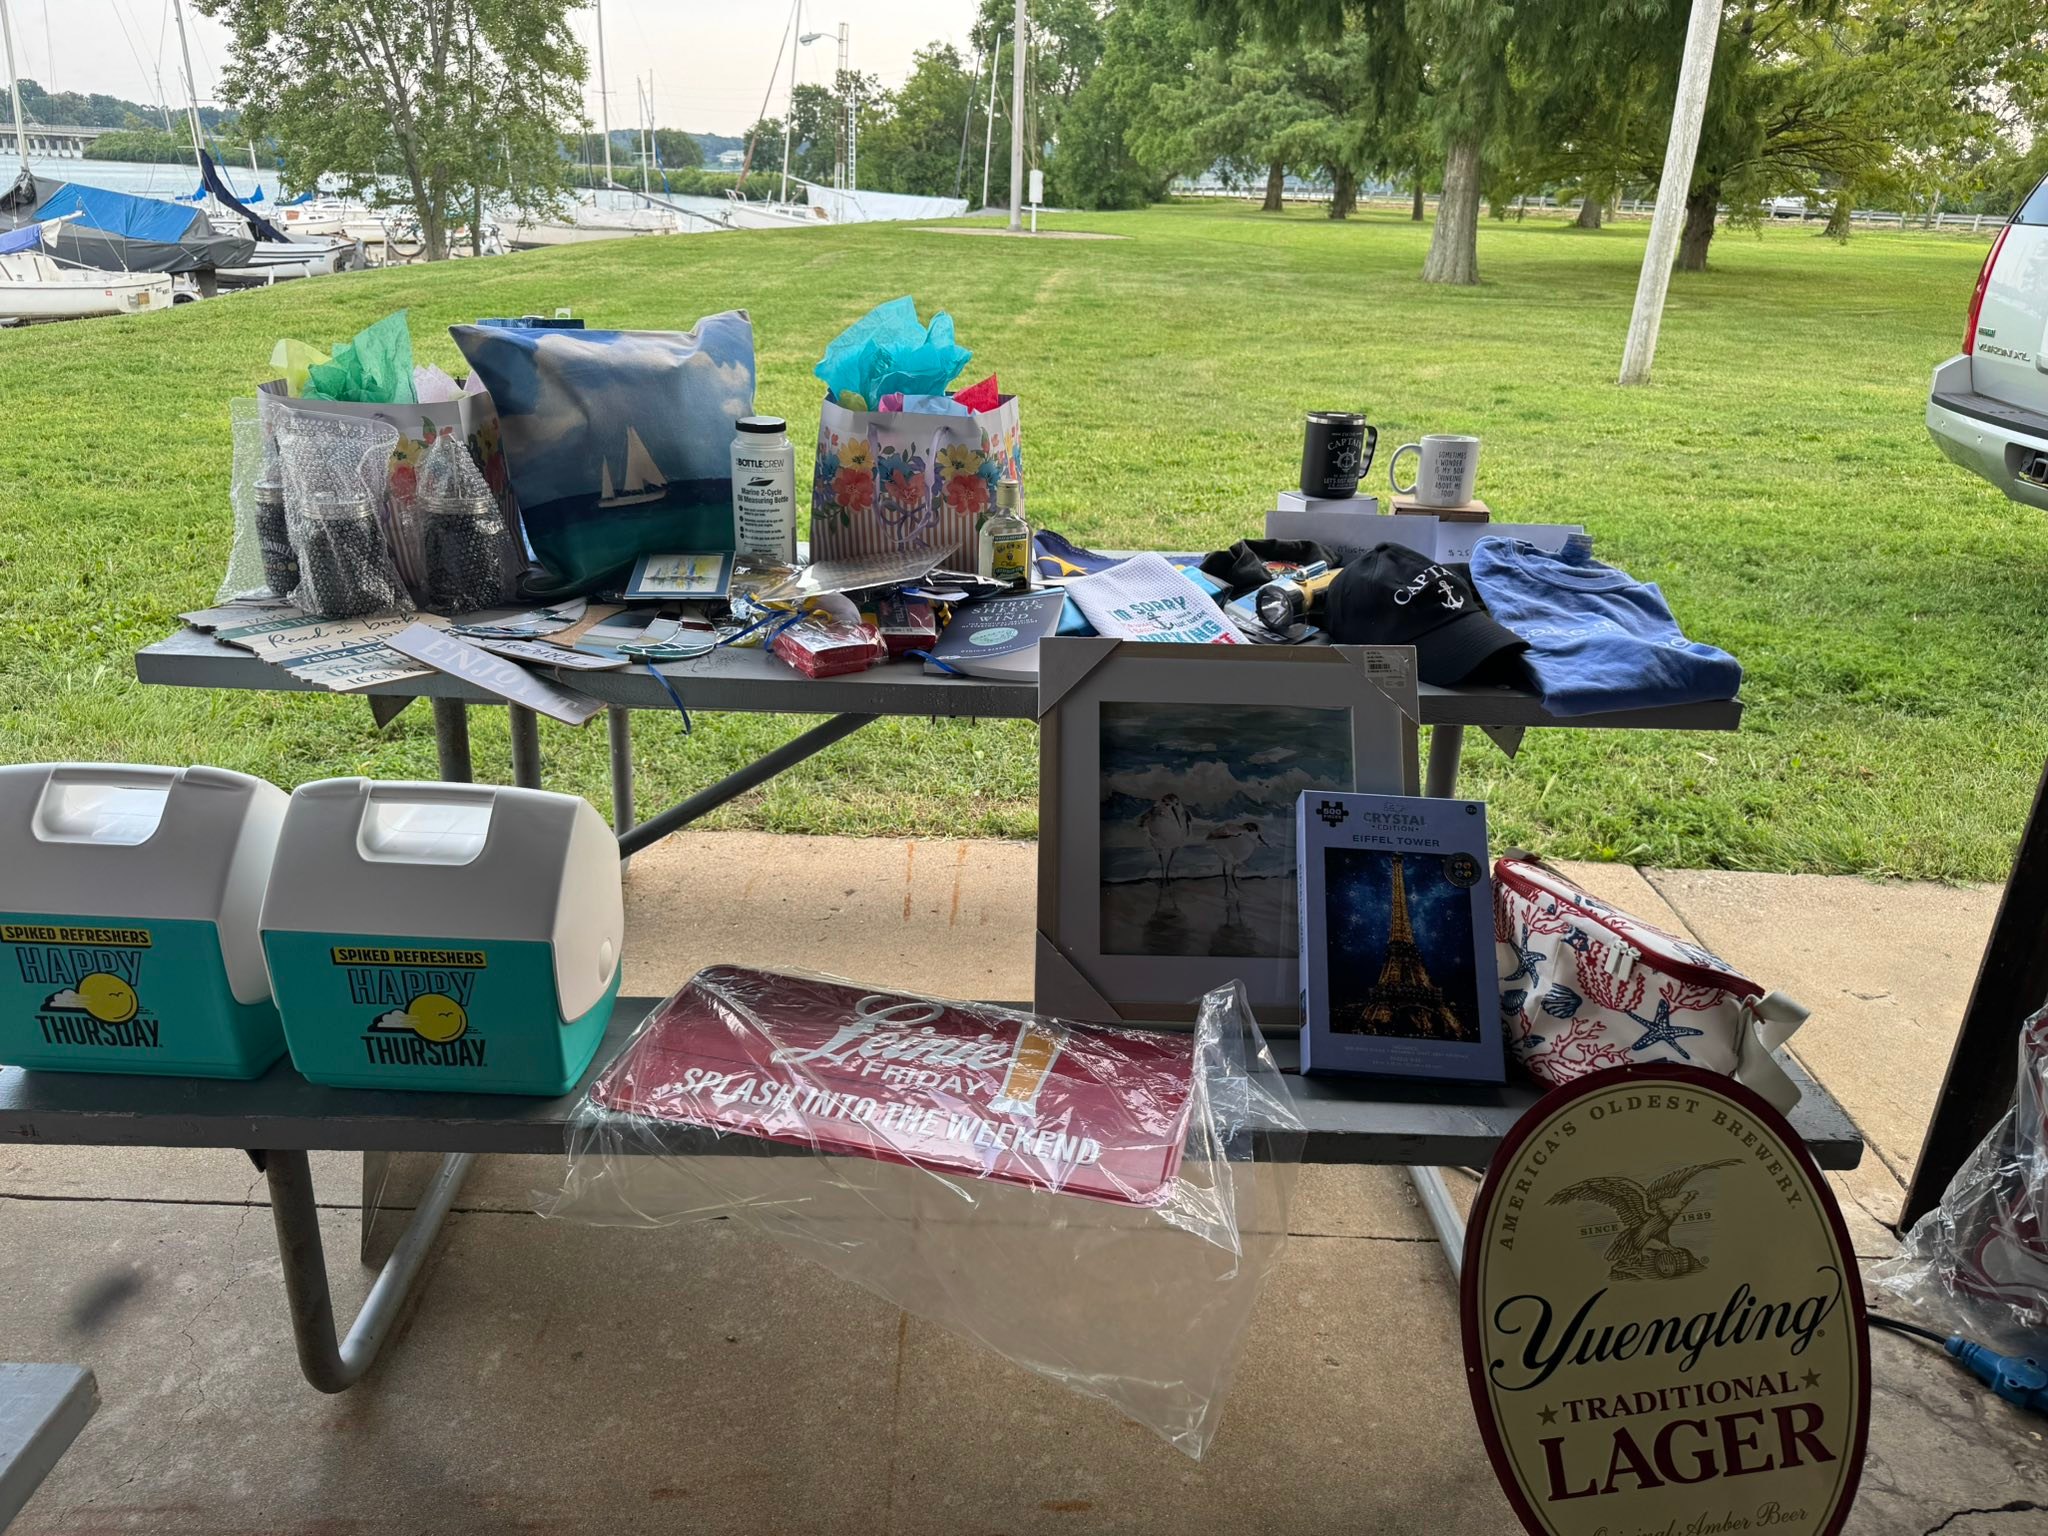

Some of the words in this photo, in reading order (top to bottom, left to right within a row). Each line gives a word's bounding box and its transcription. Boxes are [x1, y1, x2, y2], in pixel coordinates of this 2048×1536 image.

[1978, 342, 2012, 358] YUKON
[2013, 350, 2031, 362] XL
[1327, 437, 1362, 451] CAPTAIN
[741, 488, 759, 497] Marine
[761, 489, 783, 499] 2-Cycle
[744, 496, 773, 505] Measuring
[1393, 564, 1456, 606] CAPTA
[979, 612, 1029, 622] WIND
[1129, 595, 1187, 615] SORRY
[244, 622, 292, 634] FEEL
[288, 616, 326, 627] THE
[268, 626, 330, 648] Read
[361, 612, 421, 631] book
[289, 643, 332, 656] SIP
[302, 649, 354, 664] relax
[1323, 807, 1342, 815] 500
[1352, 834, 1393, 845] EIFFEL
[1397, 836, 1440, 848] TOWER
[5, 926, 56, 940] SPIKED
[59, 928, 149, 944] REFRESHERS
[16, 946, 142, 987] HAPPY
[338, 948, 390, 962] SPIKED
[394, 949, 484, 964] REFRESHERS
[347, 968, 475, 1006] HAPPY
[34, 1015, 160, 1048] THURSDAY
[360, 1036, 486, 1067] THURSDAY
[861, 1060, 986, 1096] FRIDAY
[680, 1068, 802, 1111] SPLASH
[799, 1088, 877, 1123] INTO
[880, 1101, 940, 1138] THE
[946, 1113, 1101, 1167] WEEKEND
[1499, 1121, 1578, 1251] AMERICA'S
[1590, 1095, 1700, 1122] OLDEST
[1712, 1109, 1802, 1207] BREWERY
[1580, 1223, 1619, 1237] SINCE
[1681, 1209, 1712, 1222] 1829
[1488, 1265, 1843, 1392] Yuengling
[1562, 1371, 1799, 1424] TRADITIONAL
[1538, 1402, 1837, 1503] LAGER
[1685, 1511, 1752, 1536] Amber
[1756, 1501, 1809, 1528] Beer
